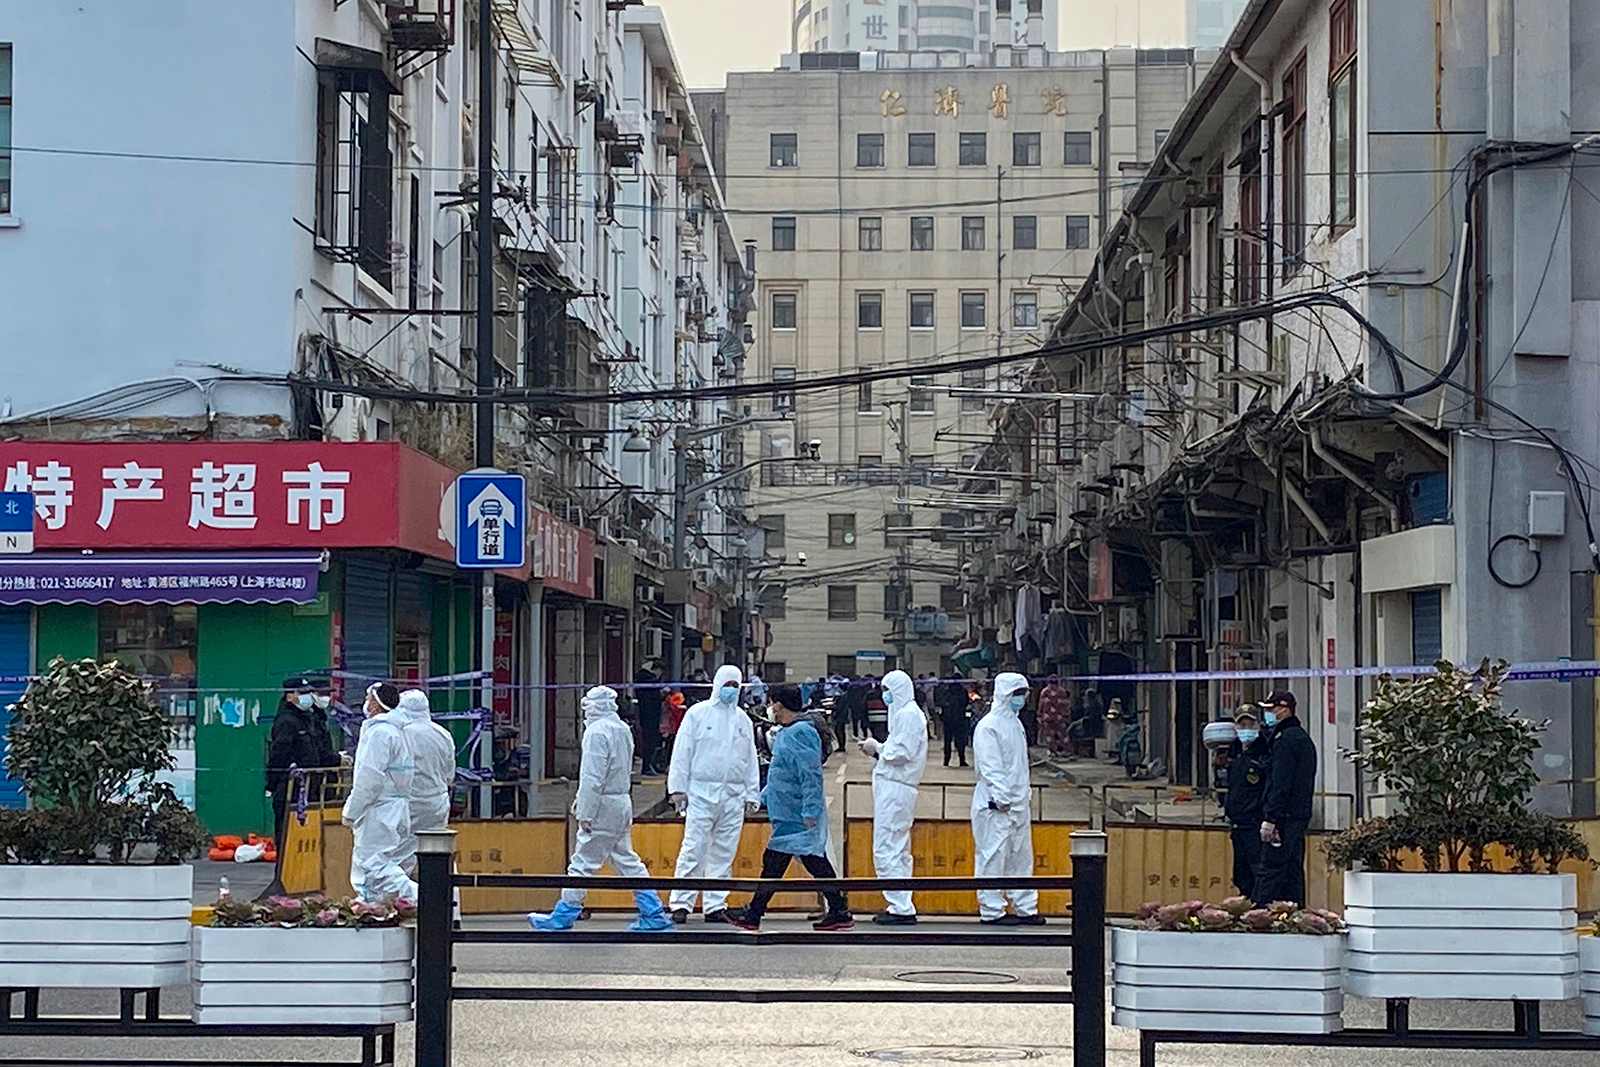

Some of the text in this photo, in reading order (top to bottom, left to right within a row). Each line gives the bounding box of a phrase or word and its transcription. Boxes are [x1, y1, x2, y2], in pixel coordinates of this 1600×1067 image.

[4, 461, 351, 531] 特产超市
[5, 499, 20, 515] 北
[6, 536, 17, 549] N
[482, 517, 501, 556] 单行道
[0, 575, 115, 590] 分热线:021-33666417
